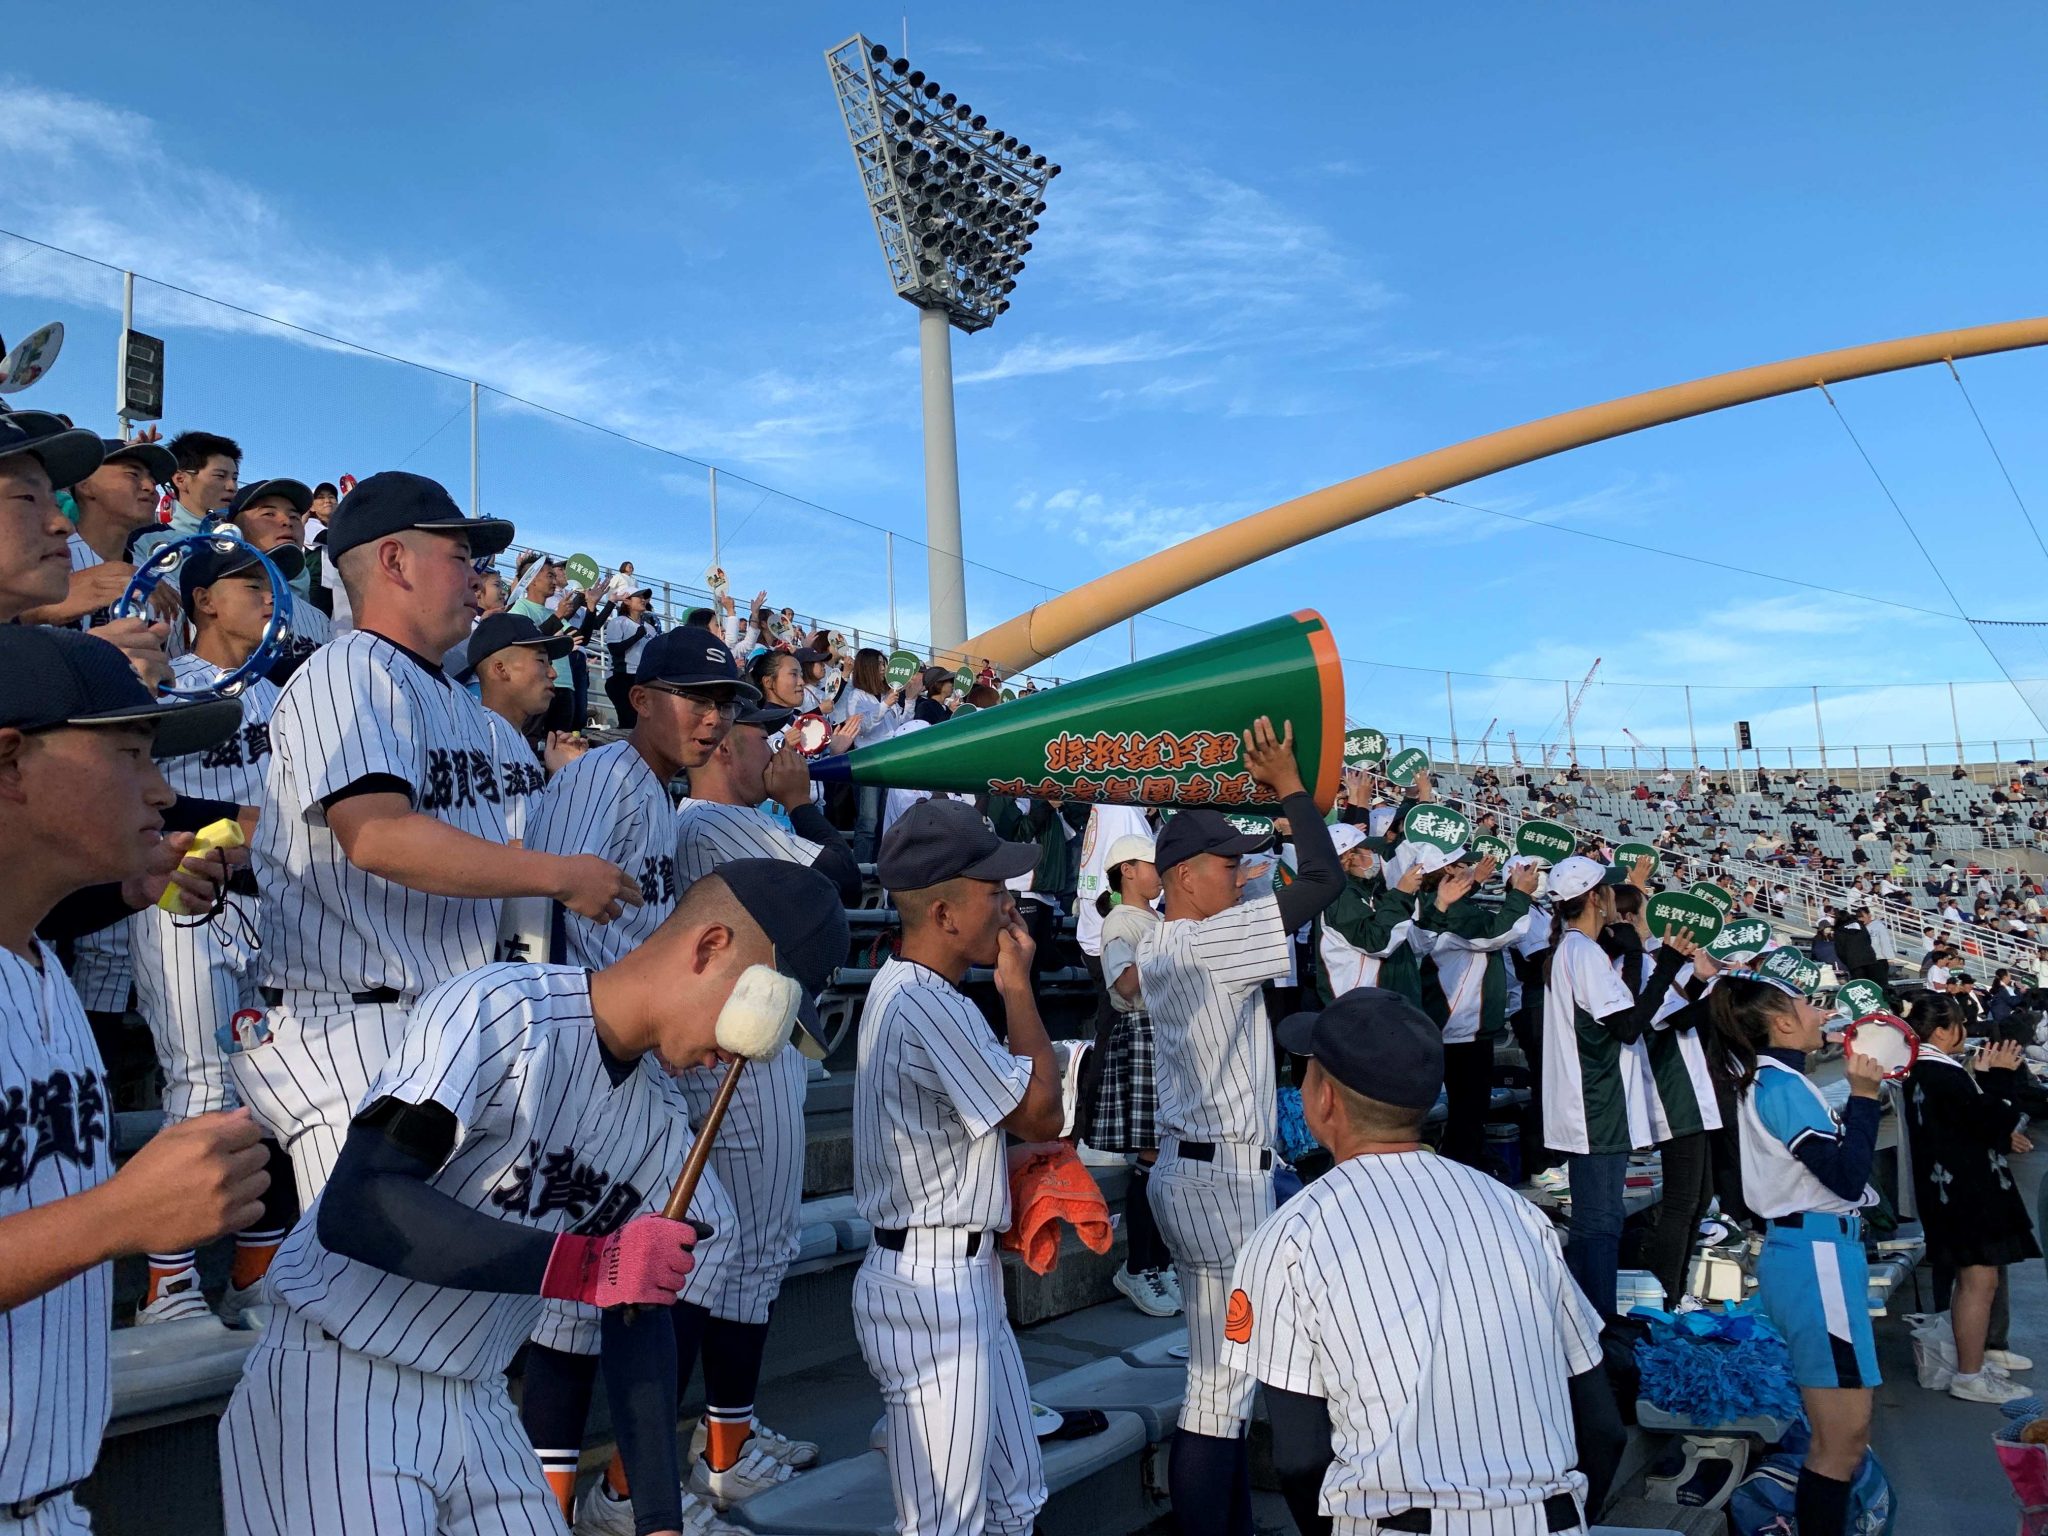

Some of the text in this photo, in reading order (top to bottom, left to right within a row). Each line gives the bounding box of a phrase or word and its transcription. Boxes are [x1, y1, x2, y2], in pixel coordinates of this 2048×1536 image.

[706, 647, 726, 664] S
[1046, 731, 1240, 773] 硬式野球部
[1343, 734, 1382, 757] 感謝
[1409, 811, 1466, 845] 感謝
[1523, 829, 1570, 852] 滋賀学園
[1619, 851, 1655, 865] 滋賀
[1655, 903, 1716, 930] 滋賀学園
[1712, 923, 1767, 950] 感謝
[1765, 951, 1799, 978] 感謝
[1789, 965, 1819, 988] 謝
